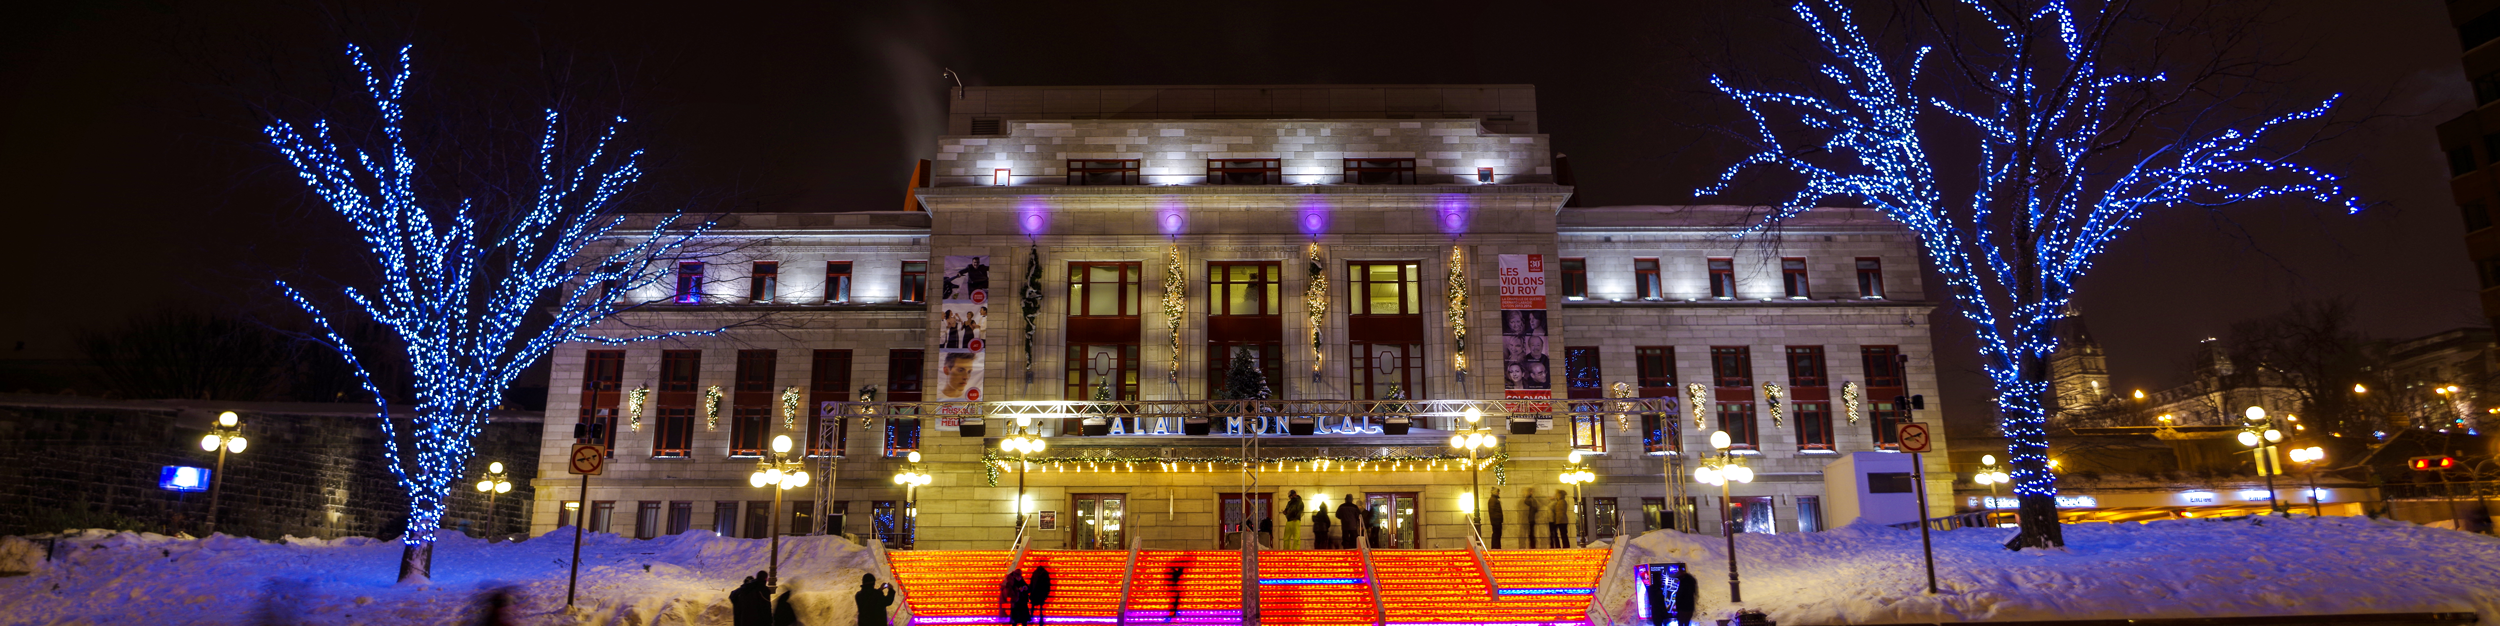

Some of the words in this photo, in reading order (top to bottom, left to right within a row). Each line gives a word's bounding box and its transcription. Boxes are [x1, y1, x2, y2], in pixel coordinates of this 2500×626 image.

[1500, 267, 1519, 276] LES
[1501, 276, 1544, 285] VIOLONS
[1501, 286, 1515, 295] DU
[1517, 286, 1538, 295] ROY
[1226, 416, 1377, 434] MONCAL
